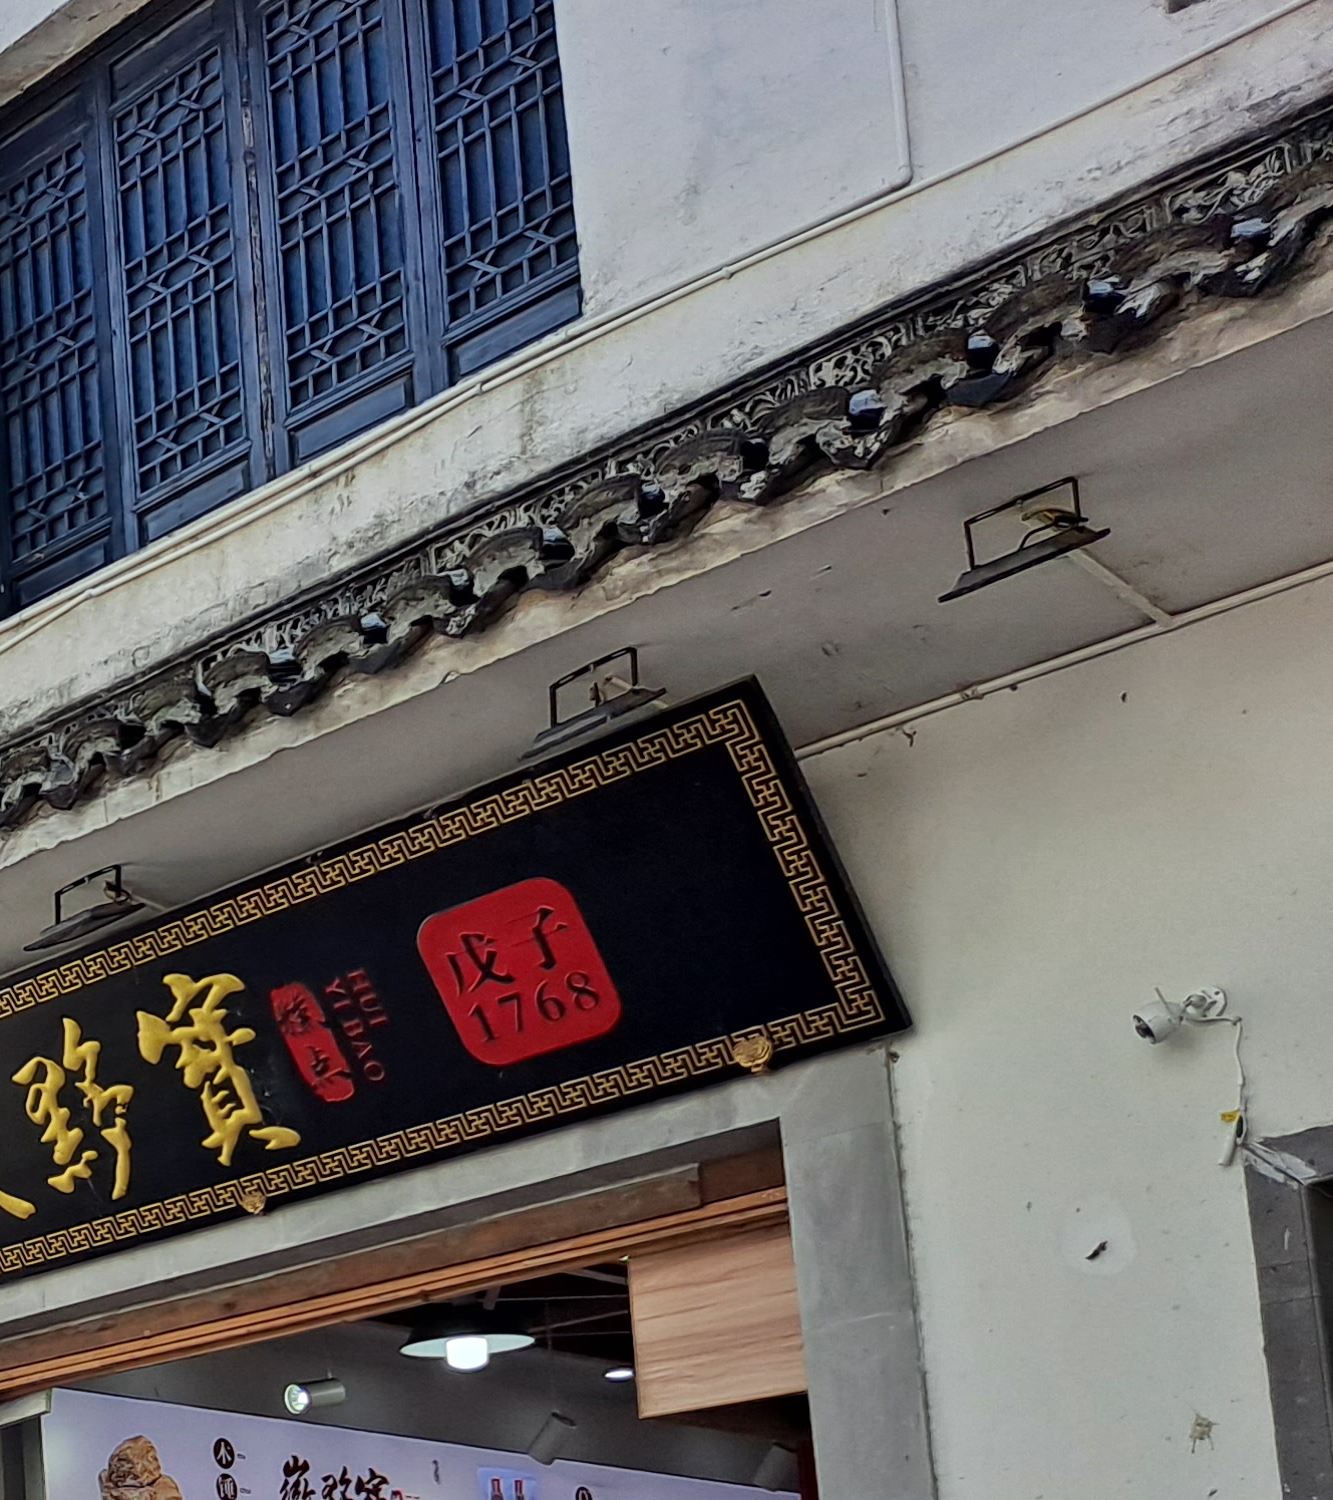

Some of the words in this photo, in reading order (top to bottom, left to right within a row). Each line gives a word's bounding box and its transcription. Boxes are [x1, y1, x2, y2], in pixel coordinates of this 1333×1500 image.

[323, 976, 349, 1012] YI
[343, 1018, 386, 1083] BAO
[347, 968, 388, 1027] HUI
[467, 969, 600, 1044] 1768
